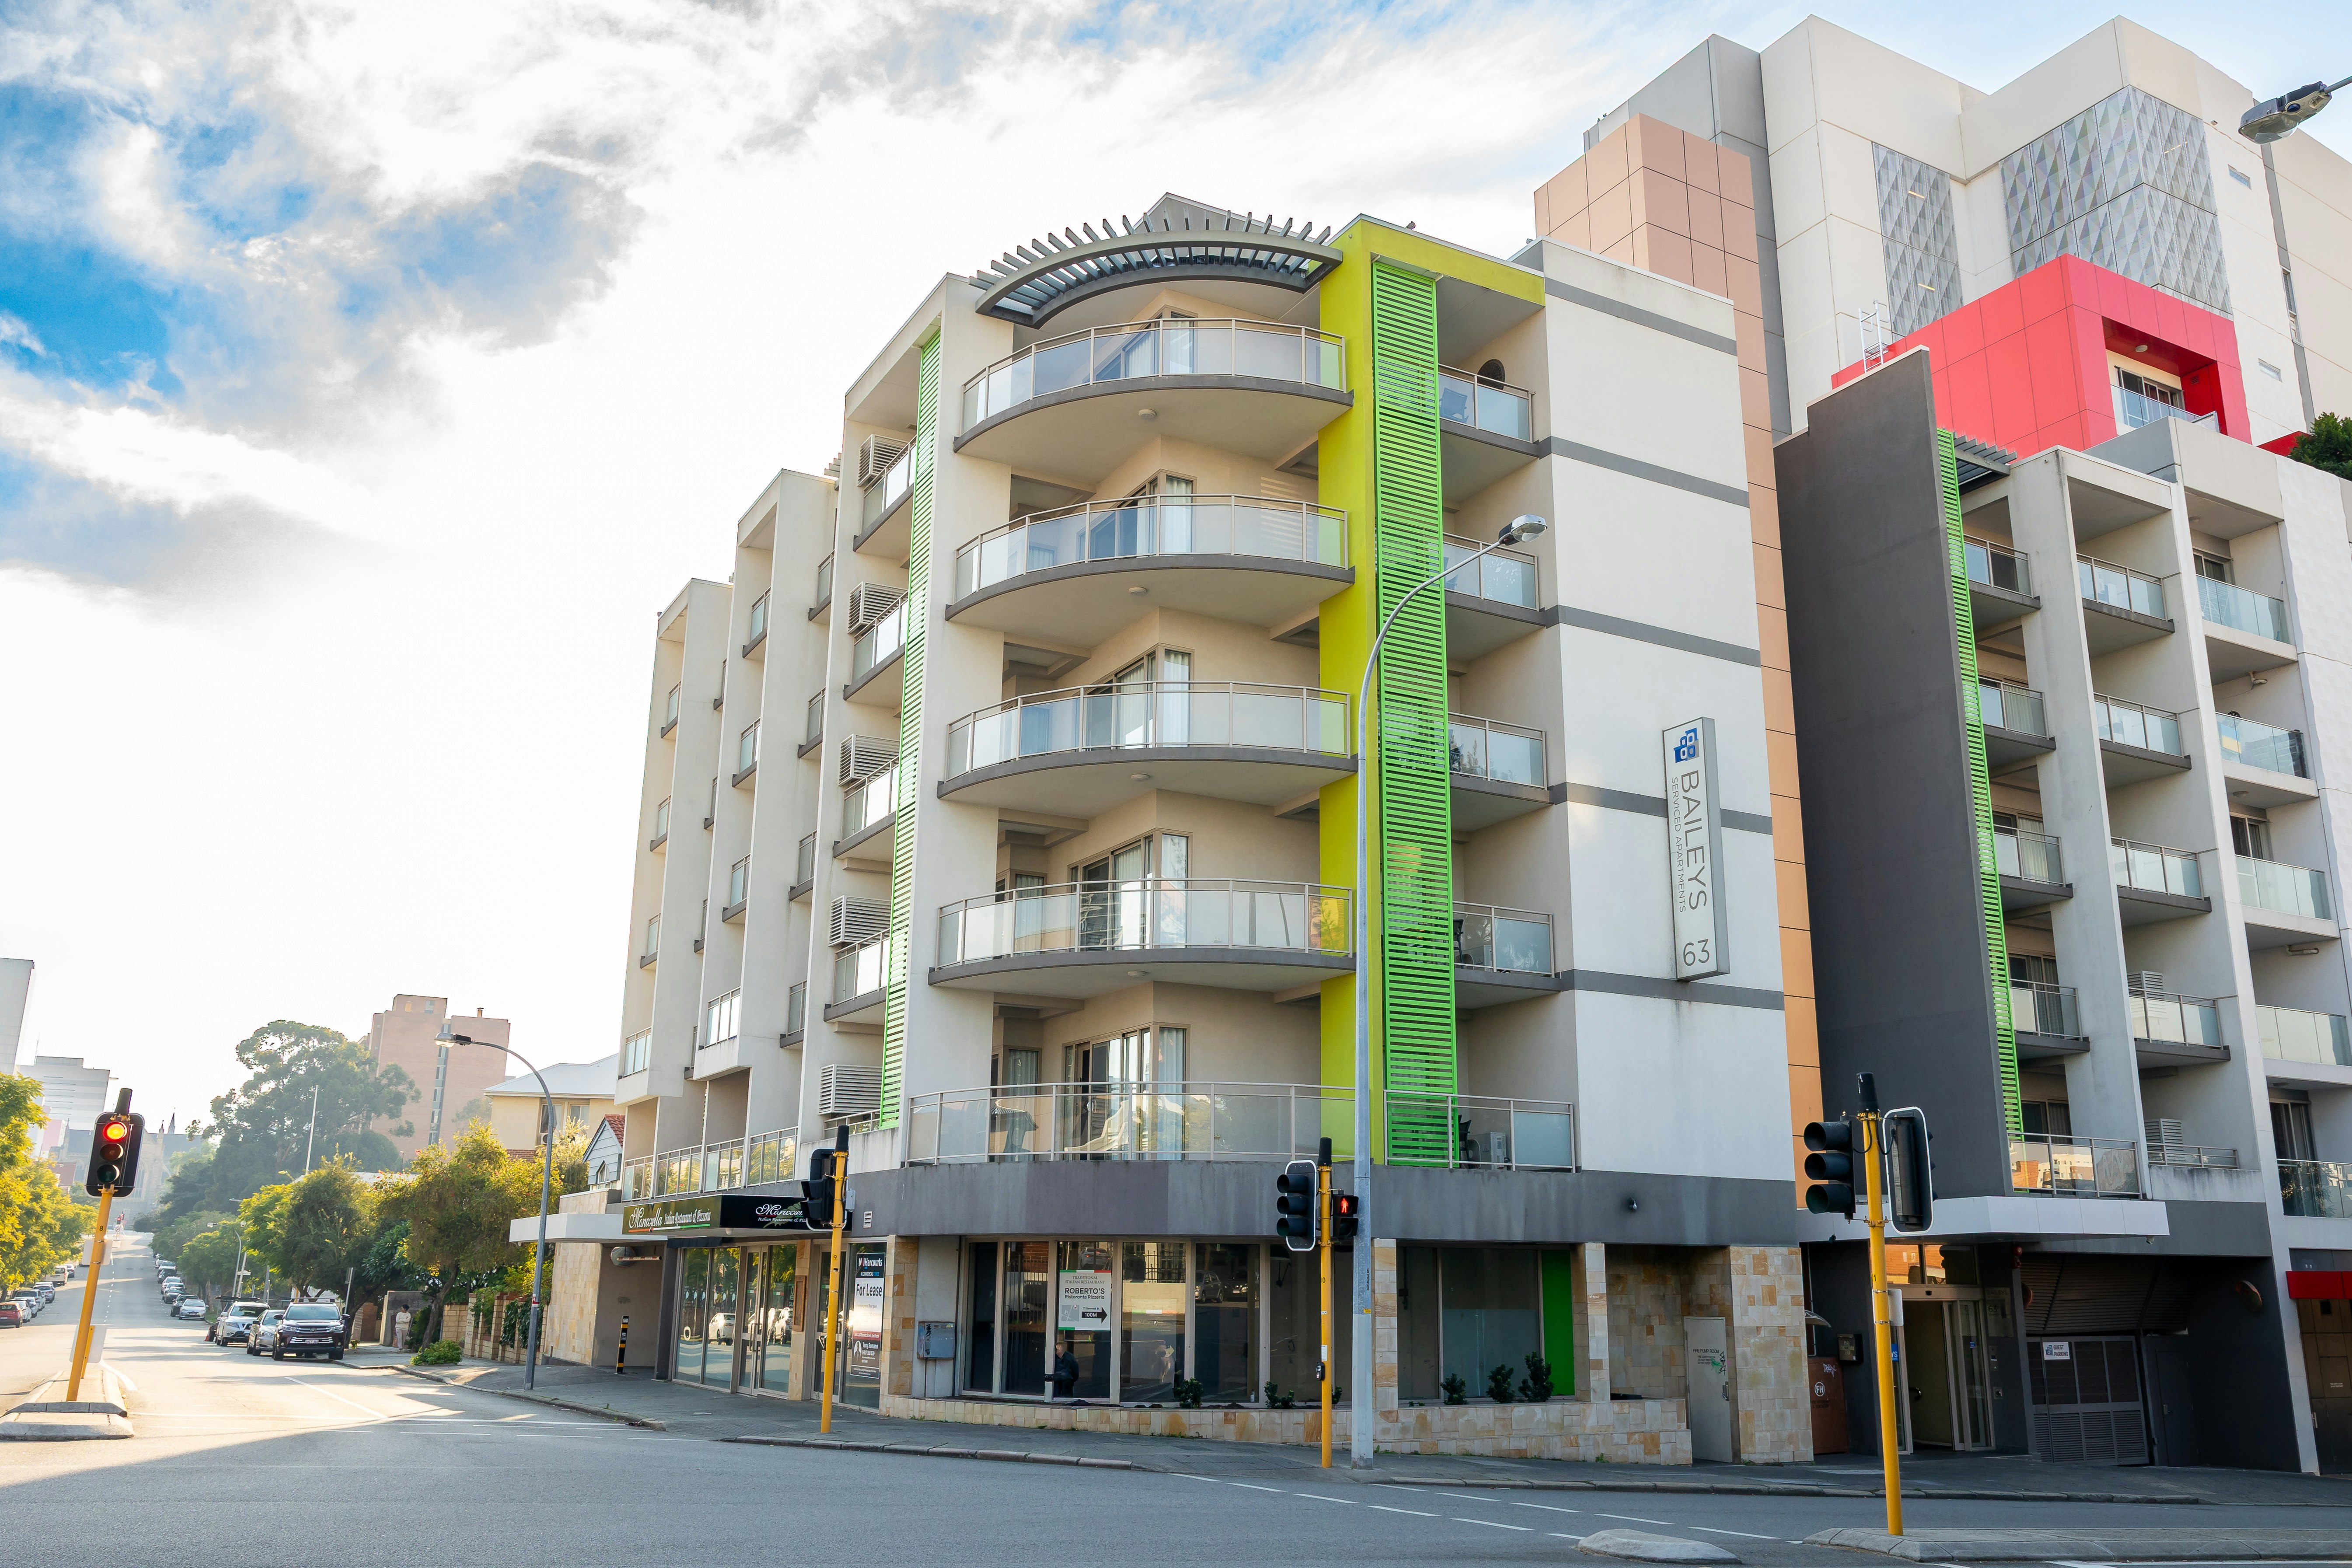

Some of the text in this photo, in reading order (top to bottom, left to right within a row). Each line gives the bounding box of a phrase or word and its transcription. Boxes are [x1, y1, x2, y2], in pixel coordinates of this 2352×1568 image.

[1672, 777, 1686, 912] SERVICED APARTMENTS
[1681, 770, 1707, 910] BAILEYS
[1683, 939, 1710, 966] 63
[629, 1207, 663, 1231] Maruzzella
[664, 1211, 675, 1225] Italian
[675, 1212, 692, 1226] Restaurant
[697, 1208, 711, 1222] Pizzeria
[865, 1258, 883, 1267] Harcourts
[856, 1283, 883, 1297] For Lease
